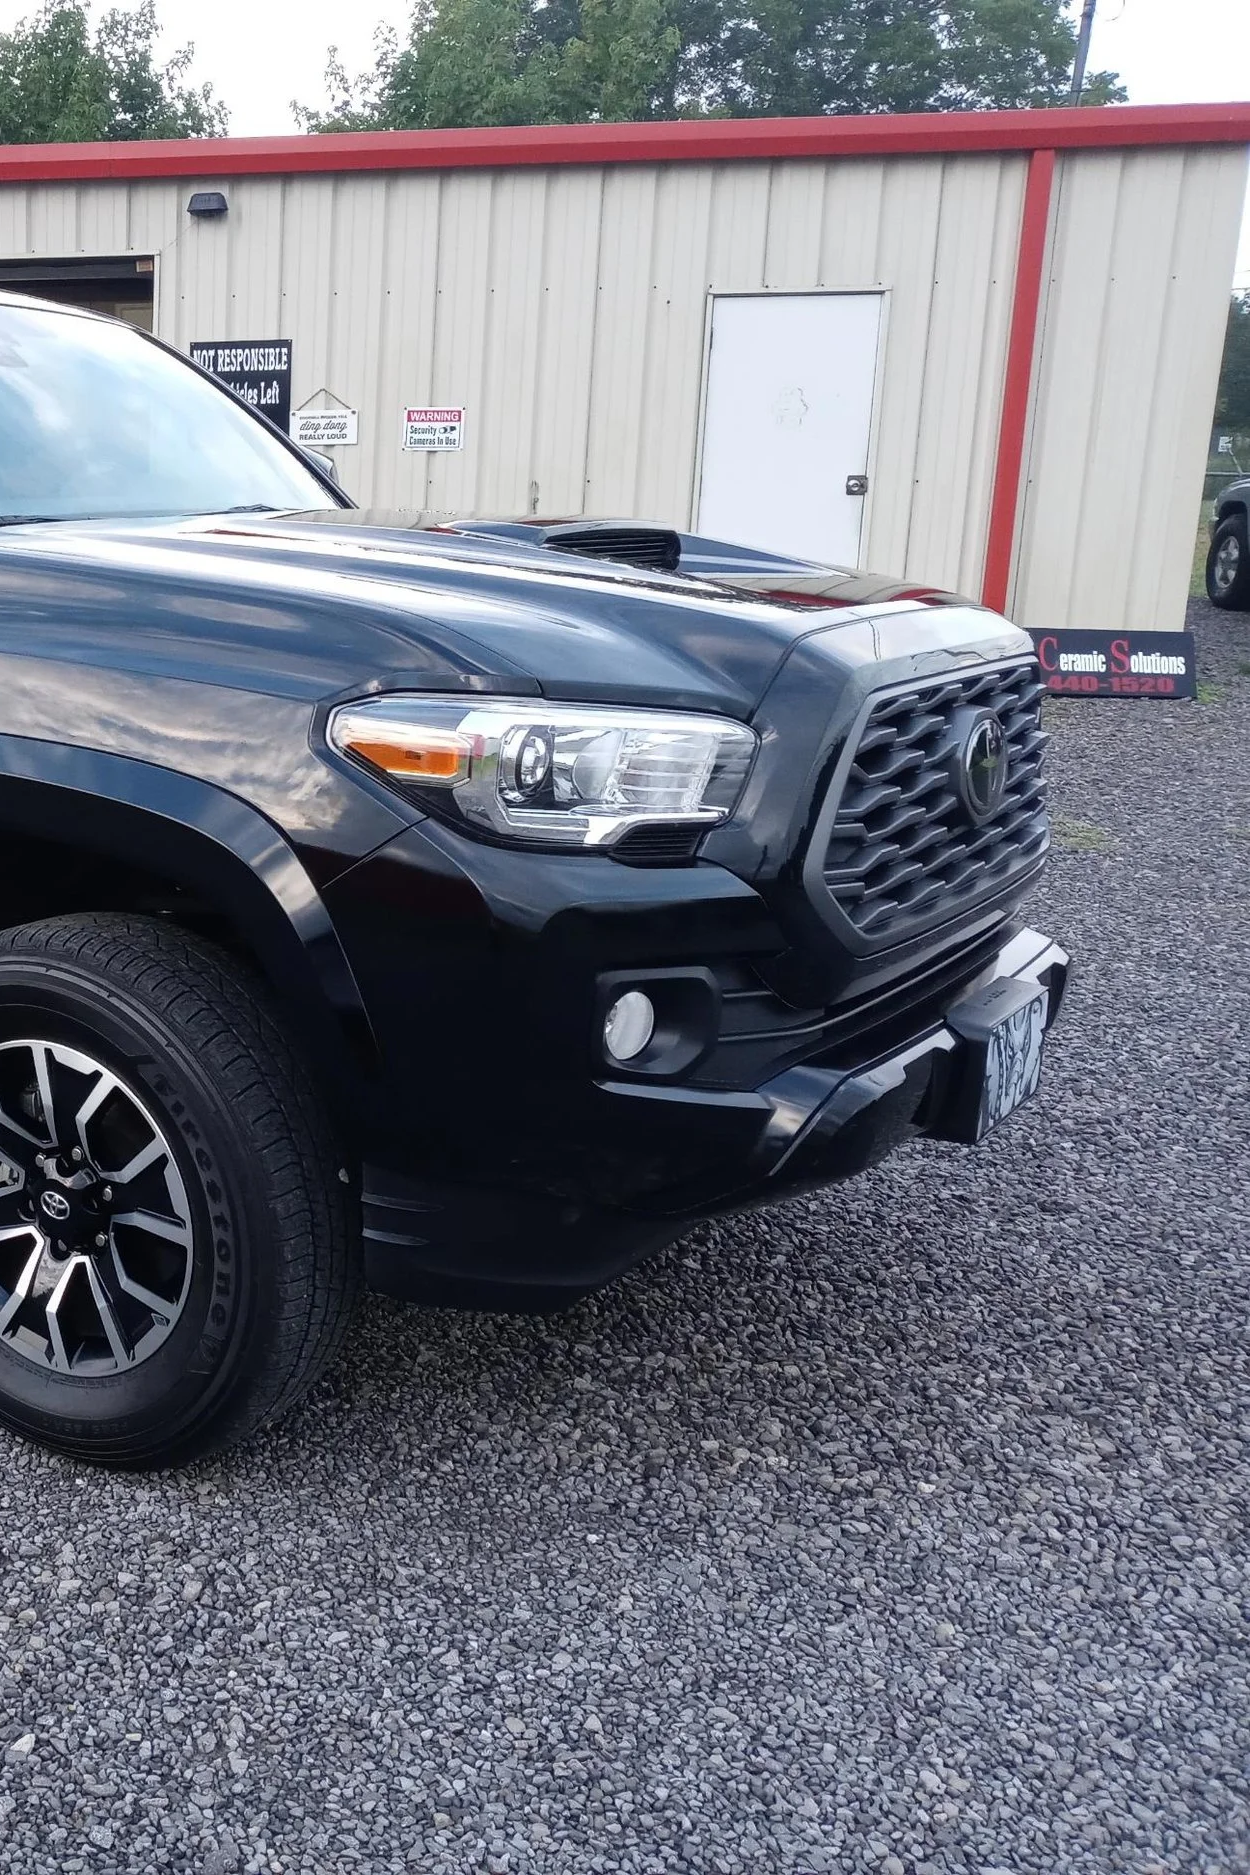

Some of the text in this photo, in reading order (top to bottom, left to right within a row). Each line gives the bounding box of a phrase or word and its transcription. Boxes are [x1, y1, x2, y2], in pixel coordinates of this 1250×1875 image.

[193, 347, 288, 373] NOT RESPONSIBLE
[260, 380, 280, 405] Left
[410, 411, 459, 422] WARNING
[299, 419, 348, 433] ding dong
[410, 425, 437, 436] Security
[409, 436, 457, 446] Cameras In Use
[1038, 636, 1186, 675] Ceramic Solutions
[1047, 674, 1175, 694] 440-1520
